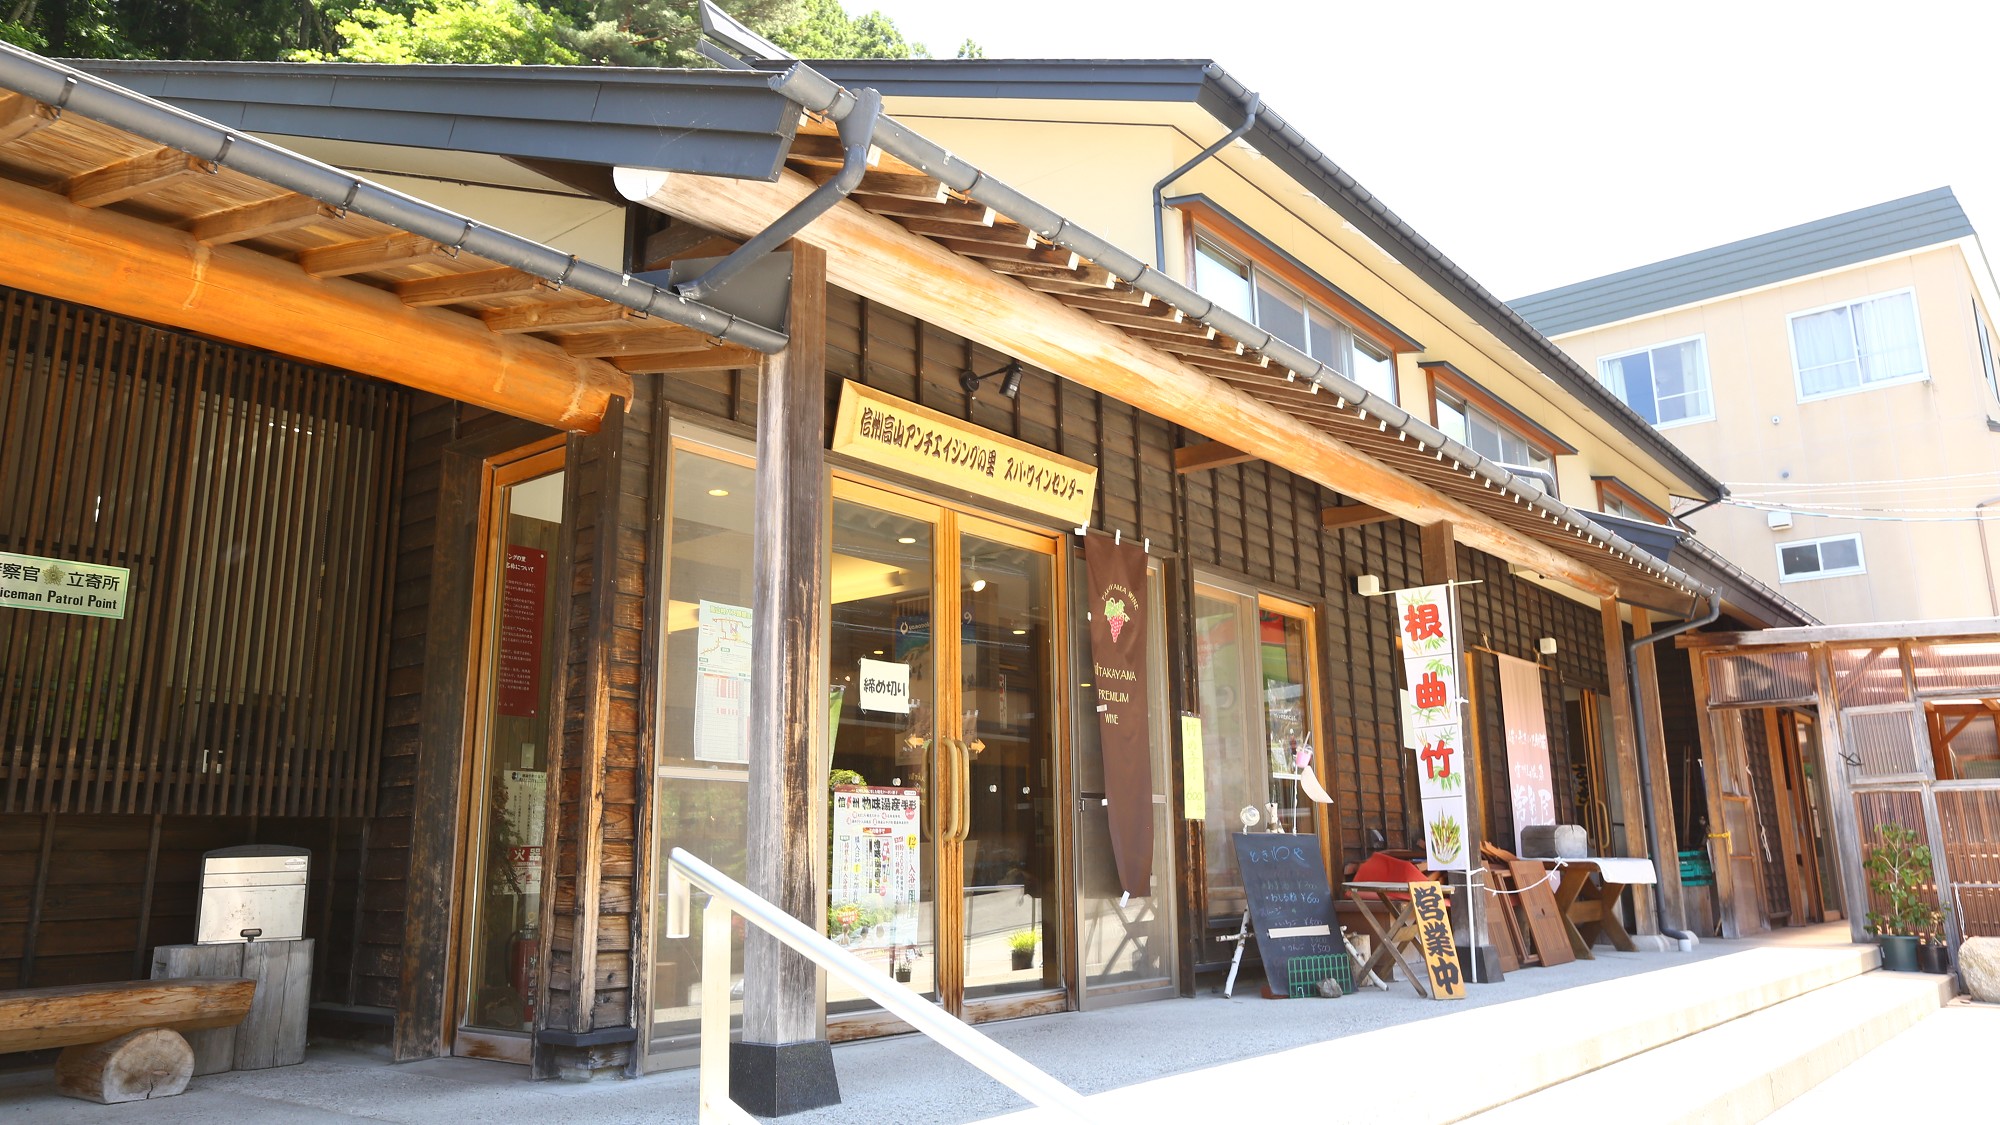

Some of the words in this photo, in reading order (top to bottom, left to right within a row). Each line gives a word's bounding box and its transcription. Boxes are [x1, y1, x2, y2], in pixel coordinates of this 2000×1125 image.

[860, 407, 996, 477] 信州高山アンチエイジングの里
[0, 562, 40, 583] 察官
[66, 571, 120, 592] 立寄所
[47, 590, 84, 606] Patrol
[88, 594, 117, 610] Point
[863, 677, 906, 697] 締め切り
[1098, 688, 1129, 703] PREMIUM
[1403, 603, 1454, 780] 根曲竹
[1104, 712, 1119, 725] WINE
[1413, 885, 1459, 995] 営業中
